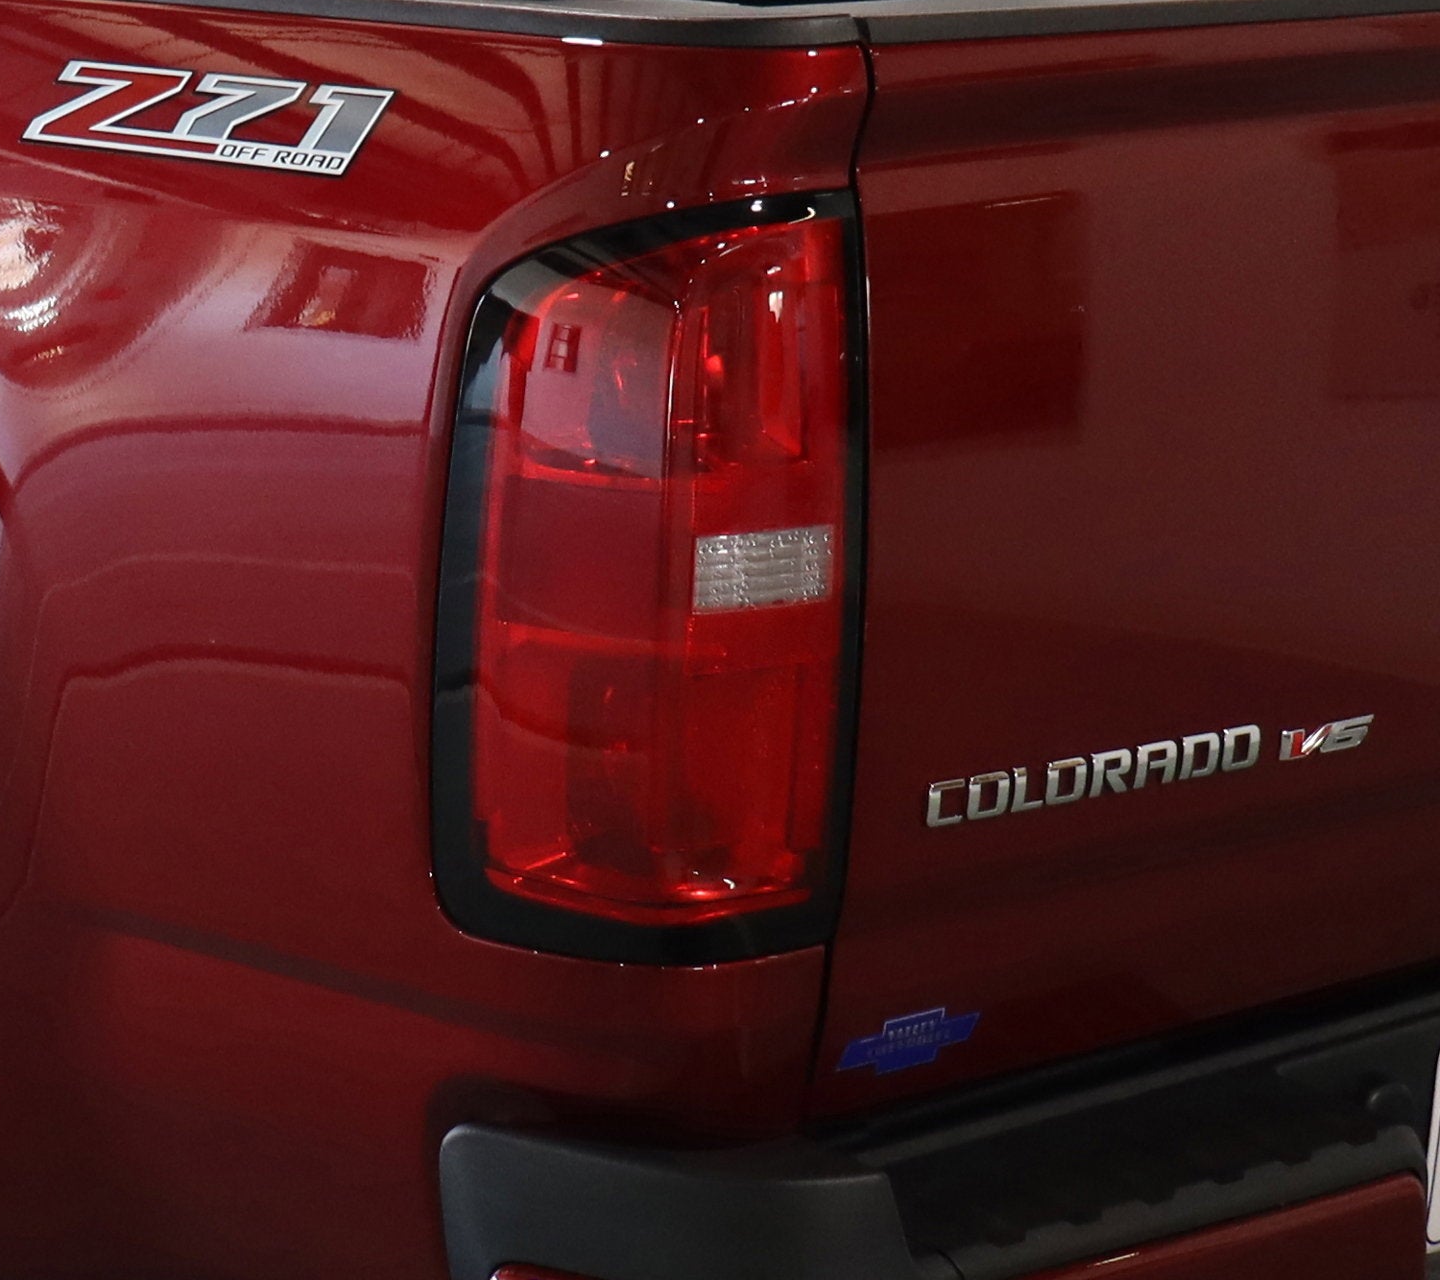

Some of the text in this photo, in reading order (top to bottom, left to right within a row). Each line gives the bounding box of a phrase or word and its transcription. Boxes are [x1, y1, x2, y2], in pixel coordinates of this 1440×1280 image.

[22, 59, 396, 160] Z71
[220, 144, 346, 171] OFF ROAD
[925, 713, 1375, 828] COLORADO V6
